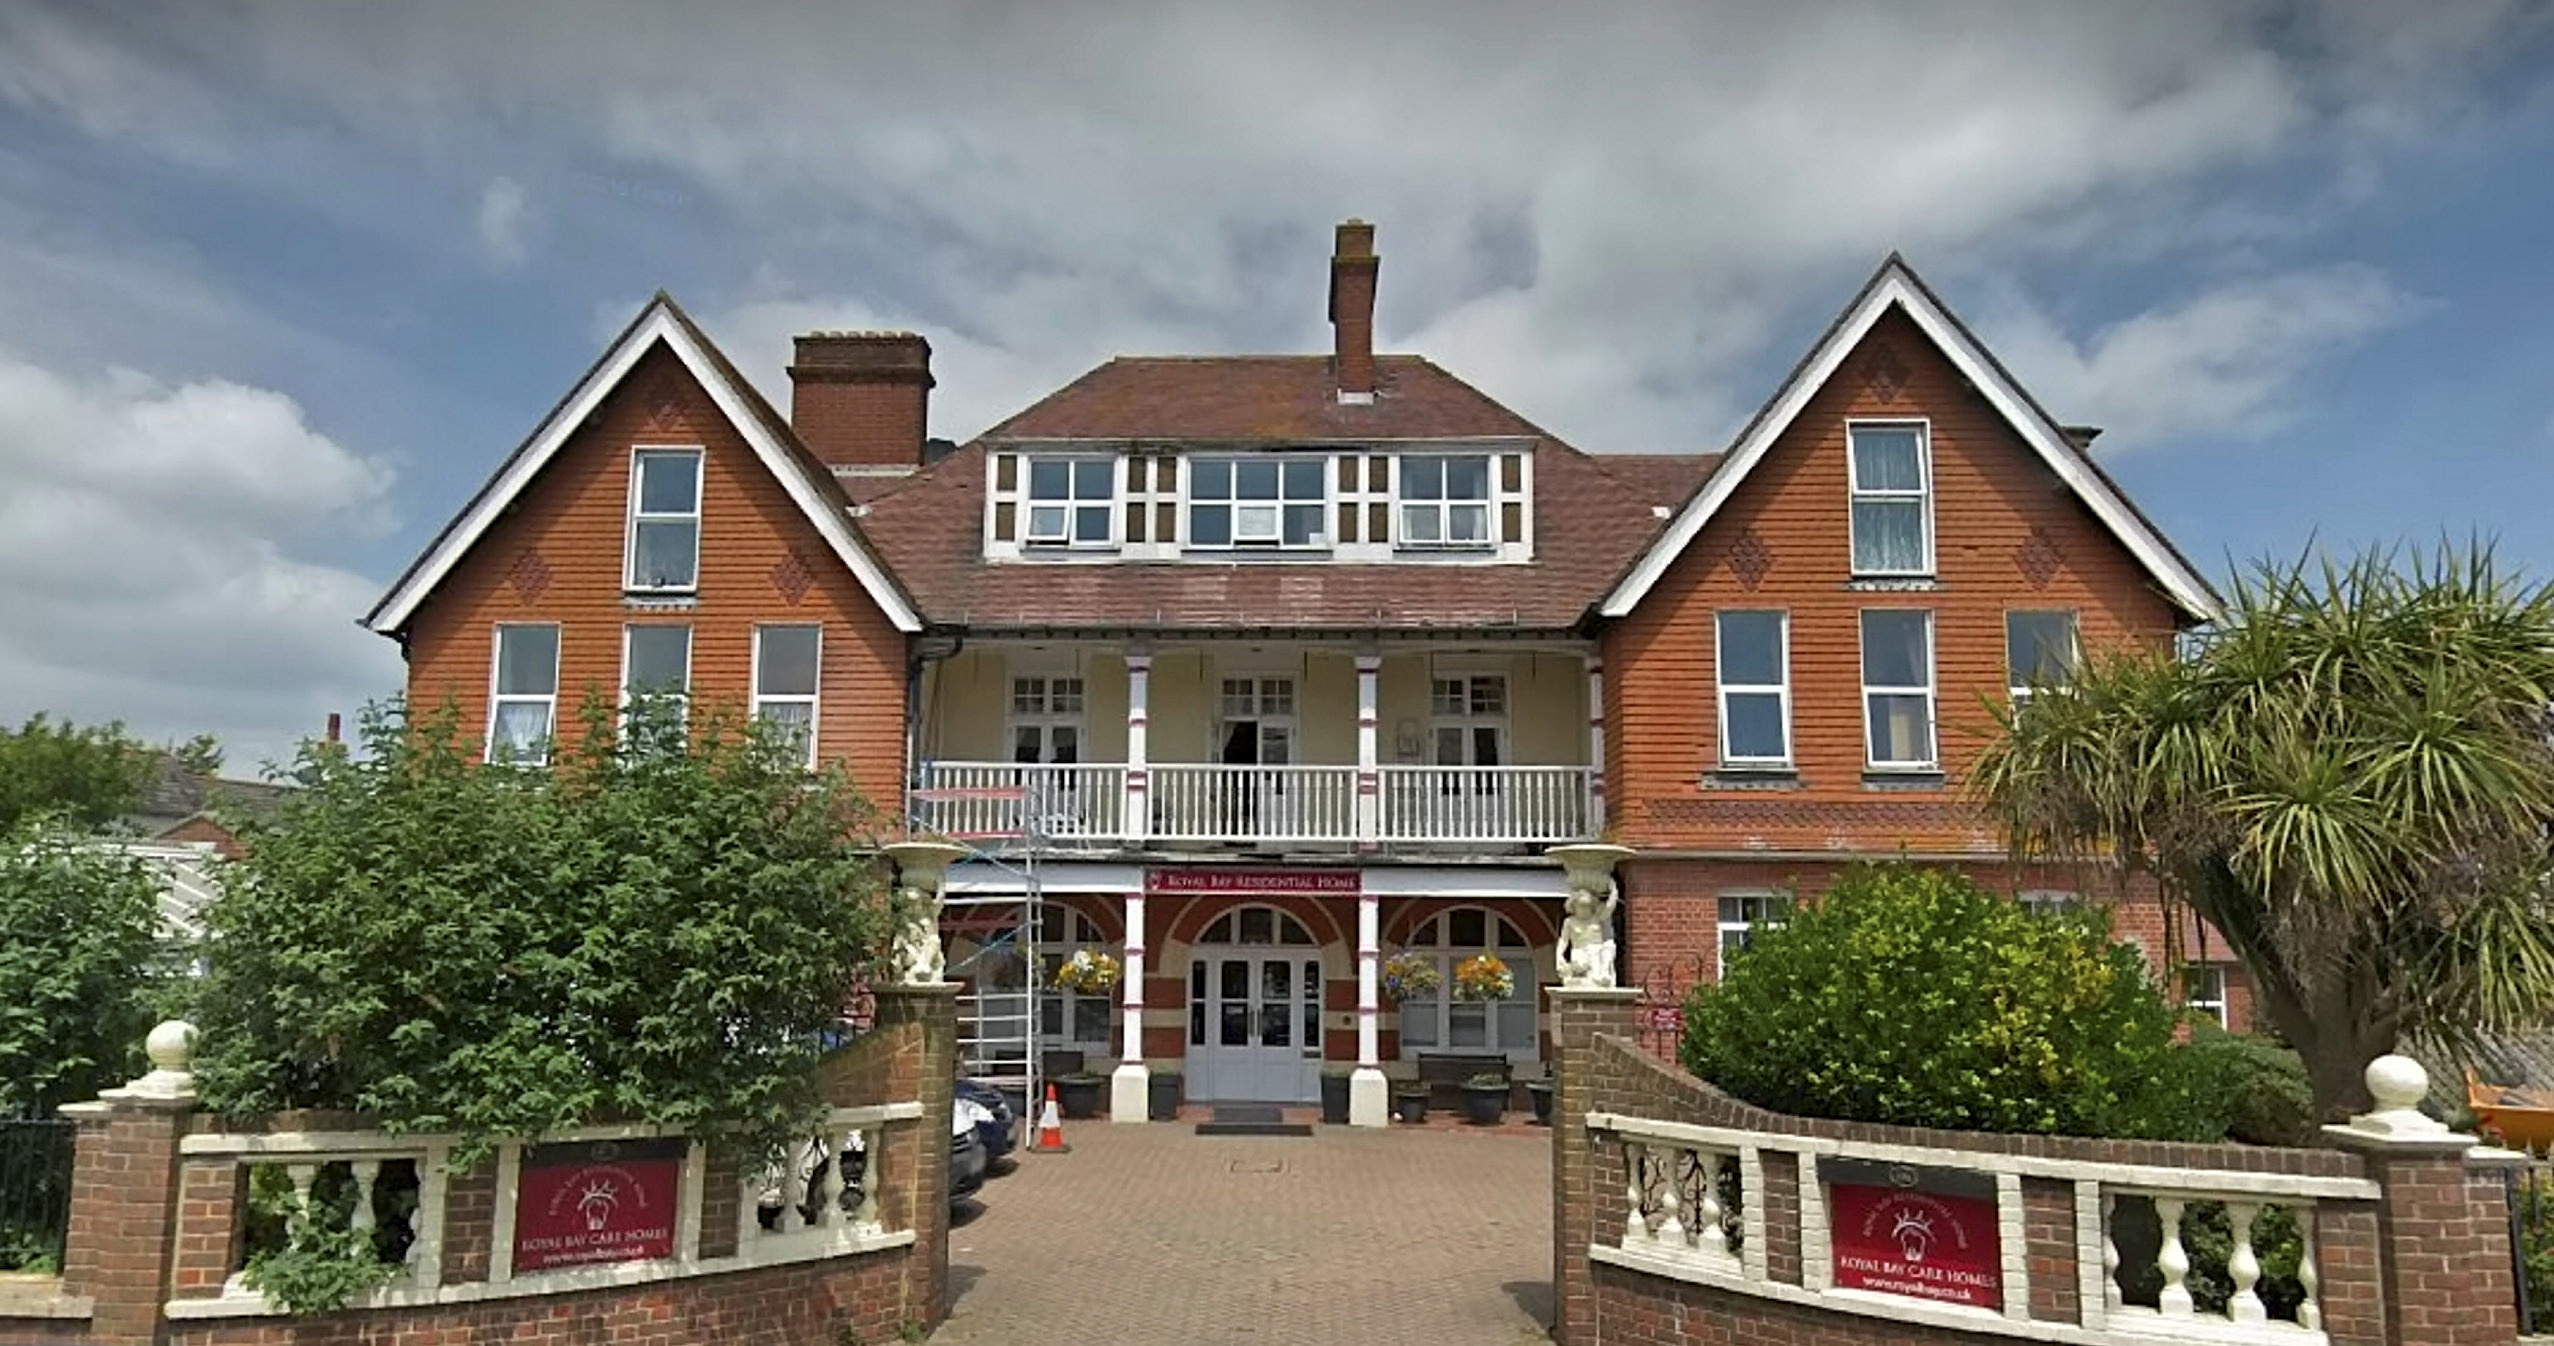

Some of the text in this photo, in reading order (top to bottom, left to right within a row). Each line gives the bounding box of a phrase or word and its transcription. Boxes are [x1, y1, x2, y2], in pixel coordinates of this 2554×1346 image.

[565, 1233, 588, 1247] BAY
[588, 1230, 621, 1245] CARE
[1840, 1255, 1997, 1288] ROYAL BAY CARE HOMES
